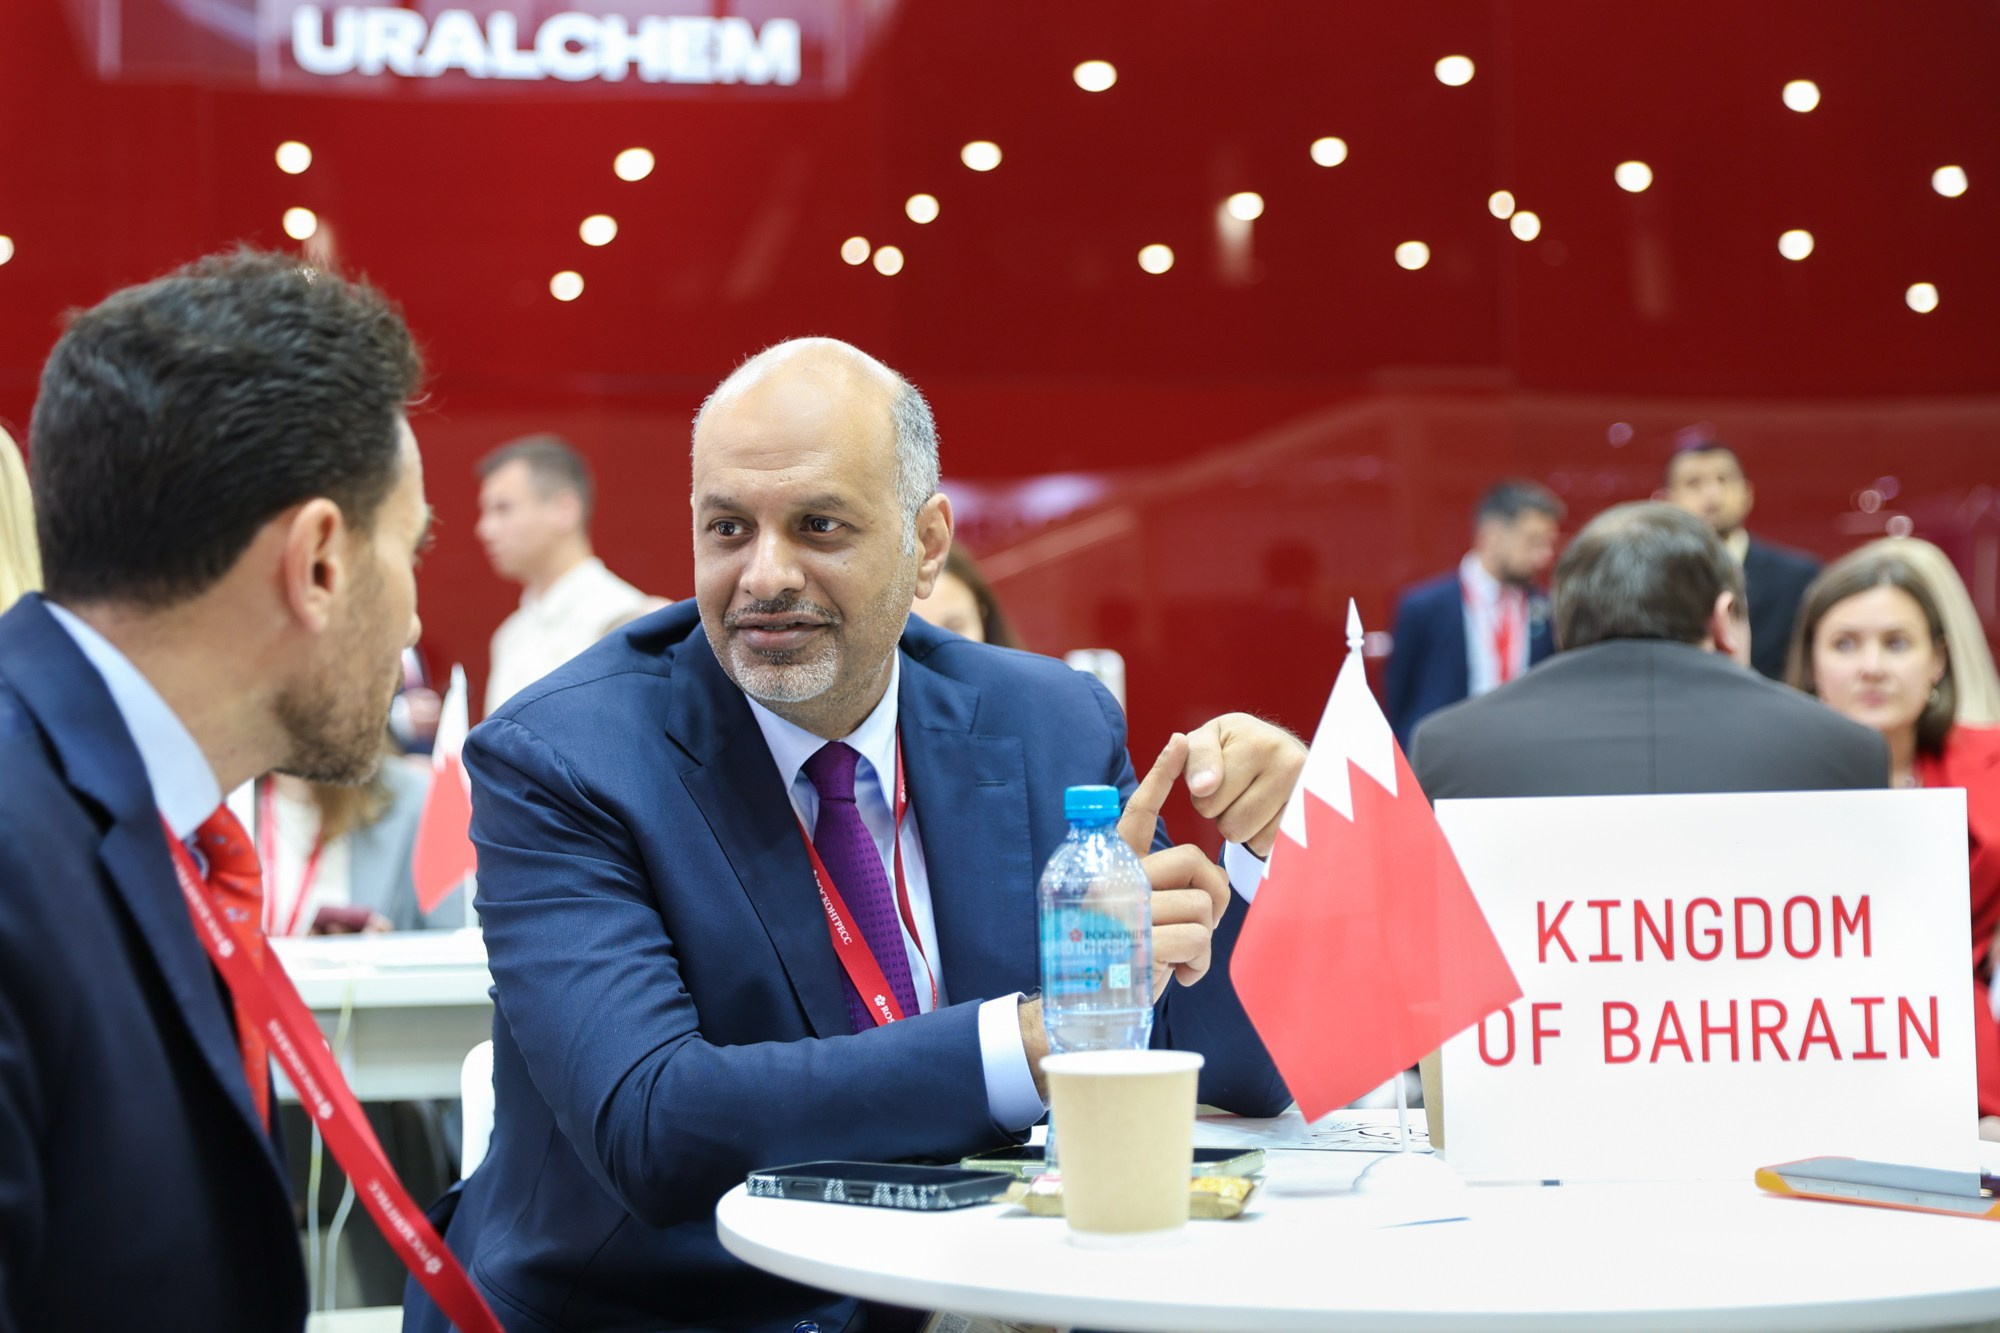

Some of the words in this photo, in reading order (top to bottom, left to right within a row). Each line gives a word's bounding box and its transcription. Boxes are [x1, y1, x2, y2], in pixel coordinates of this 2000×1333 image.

[294, 7, 800, 85] URALCHEM
[1537, 895, 1871, 963] KINGDOM
[1478, 1002, 1563, 1066] OF
[1602, 996, 1940, 1064] BAHRAIN
